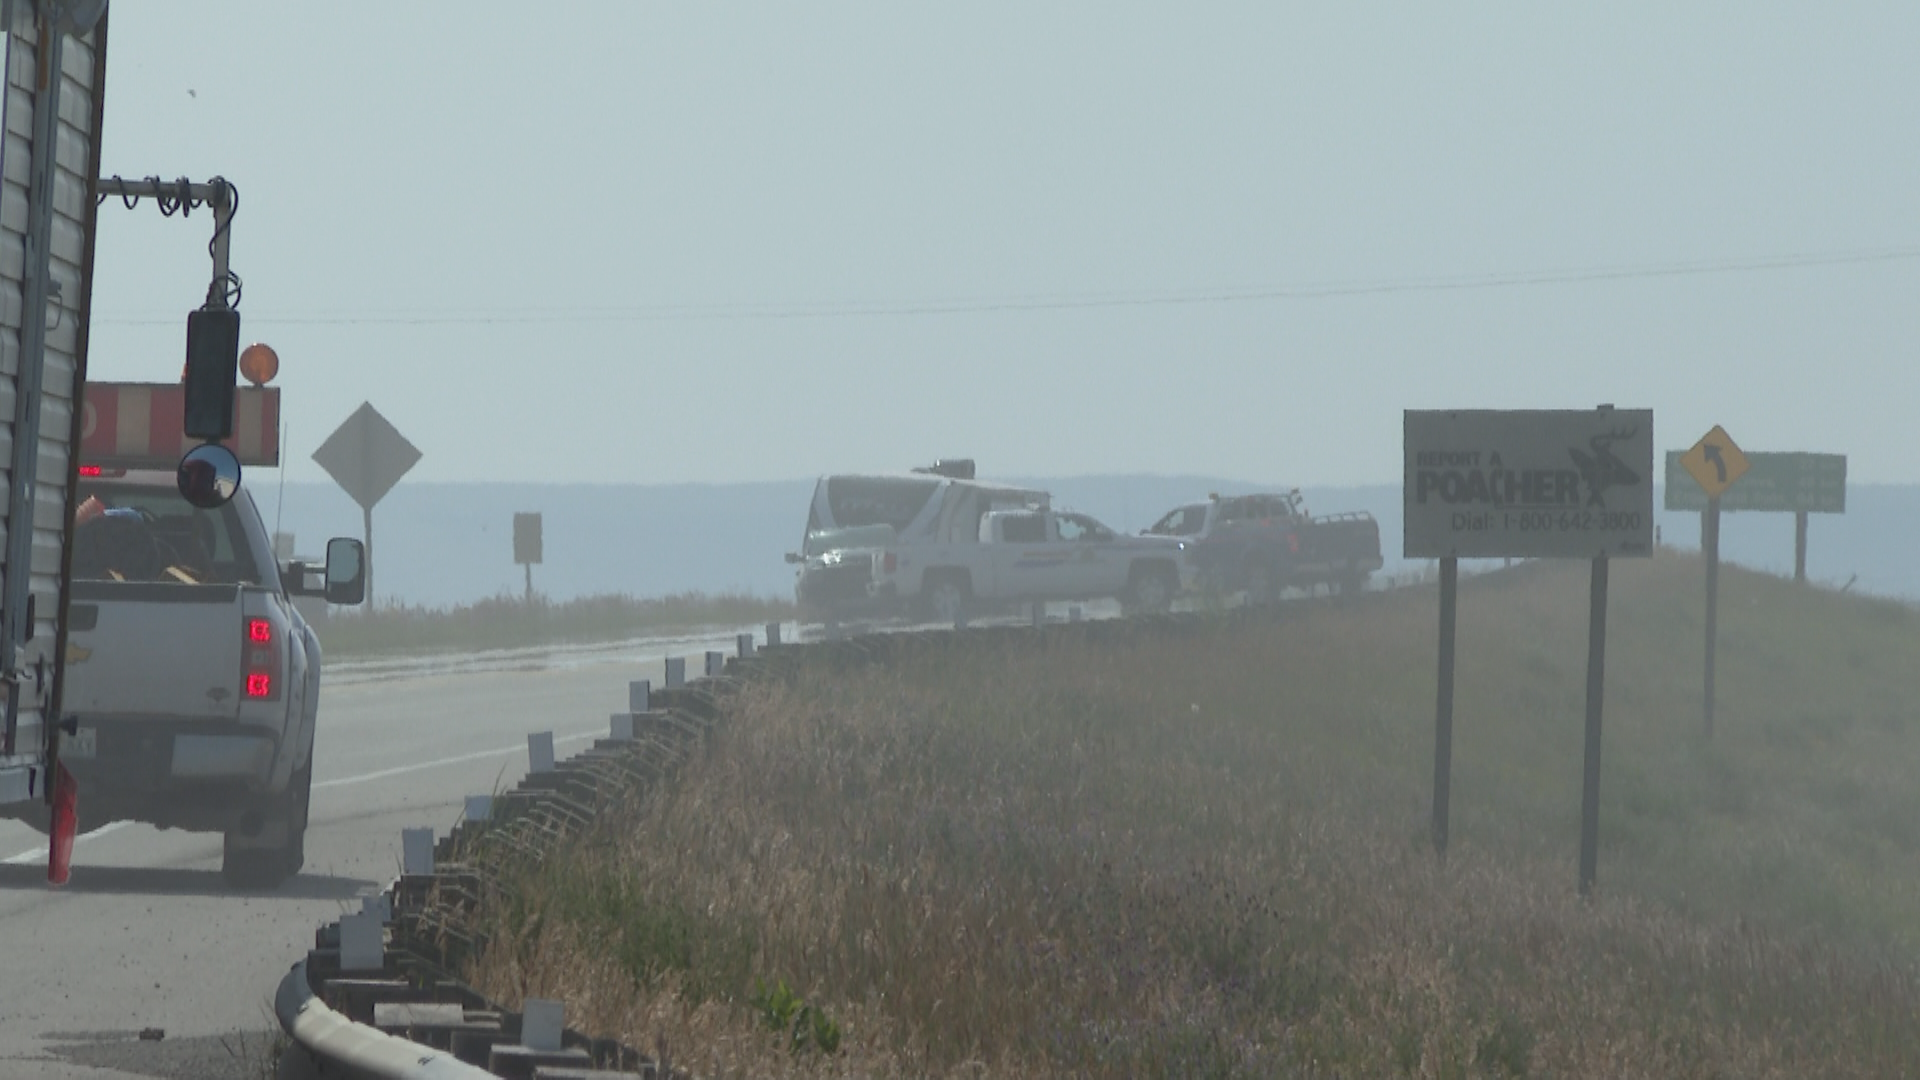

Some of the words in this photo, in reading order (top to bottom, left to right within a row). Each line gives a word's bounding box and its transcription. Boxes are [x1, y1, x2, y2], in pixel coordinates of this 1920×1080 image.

[1417, 451, 1481, 466] REPORT
[1489, 451, 1502, 466] A
[1416, 469, 1580, 507] POACHER
[1452, 512, 1494, 530] Dial:
[1503, 512, 1641, 531] 1-800-642-3800
